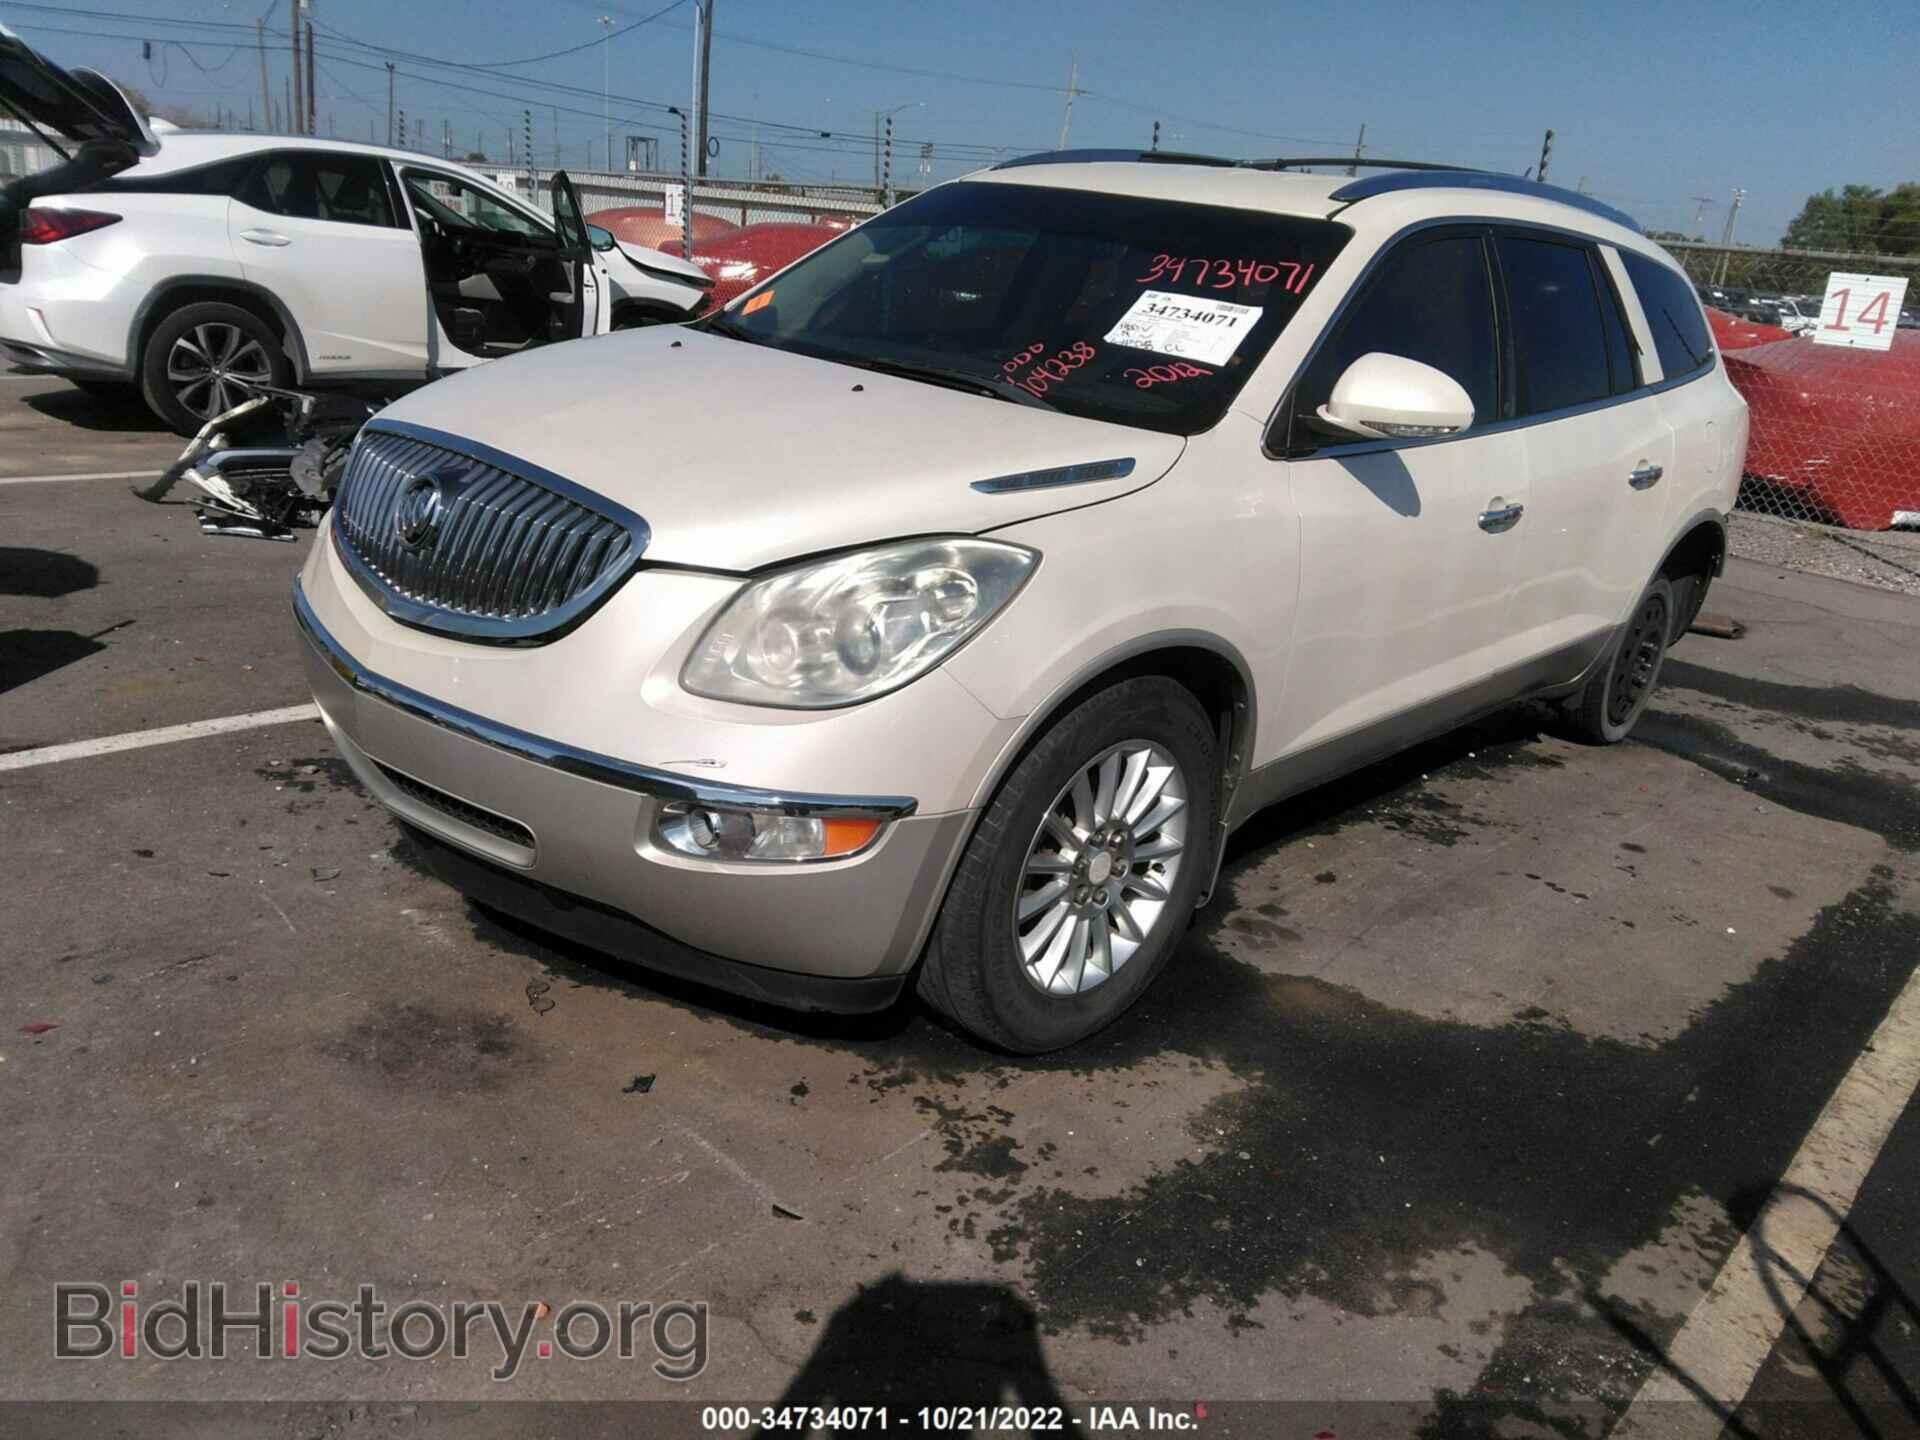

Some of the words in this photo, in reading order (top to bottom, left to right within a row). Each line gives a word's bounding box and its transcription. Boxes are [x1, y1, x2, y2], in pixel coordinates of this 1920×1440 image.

[1136, 254, 1314, 294] 34734071
[1141, 303, 1239, 328] 34734071
[1823, 287, 1890, 334] 14
[1015, 340, 1096, 398] 104238
[1122, 361, 1215, 389] 2012
